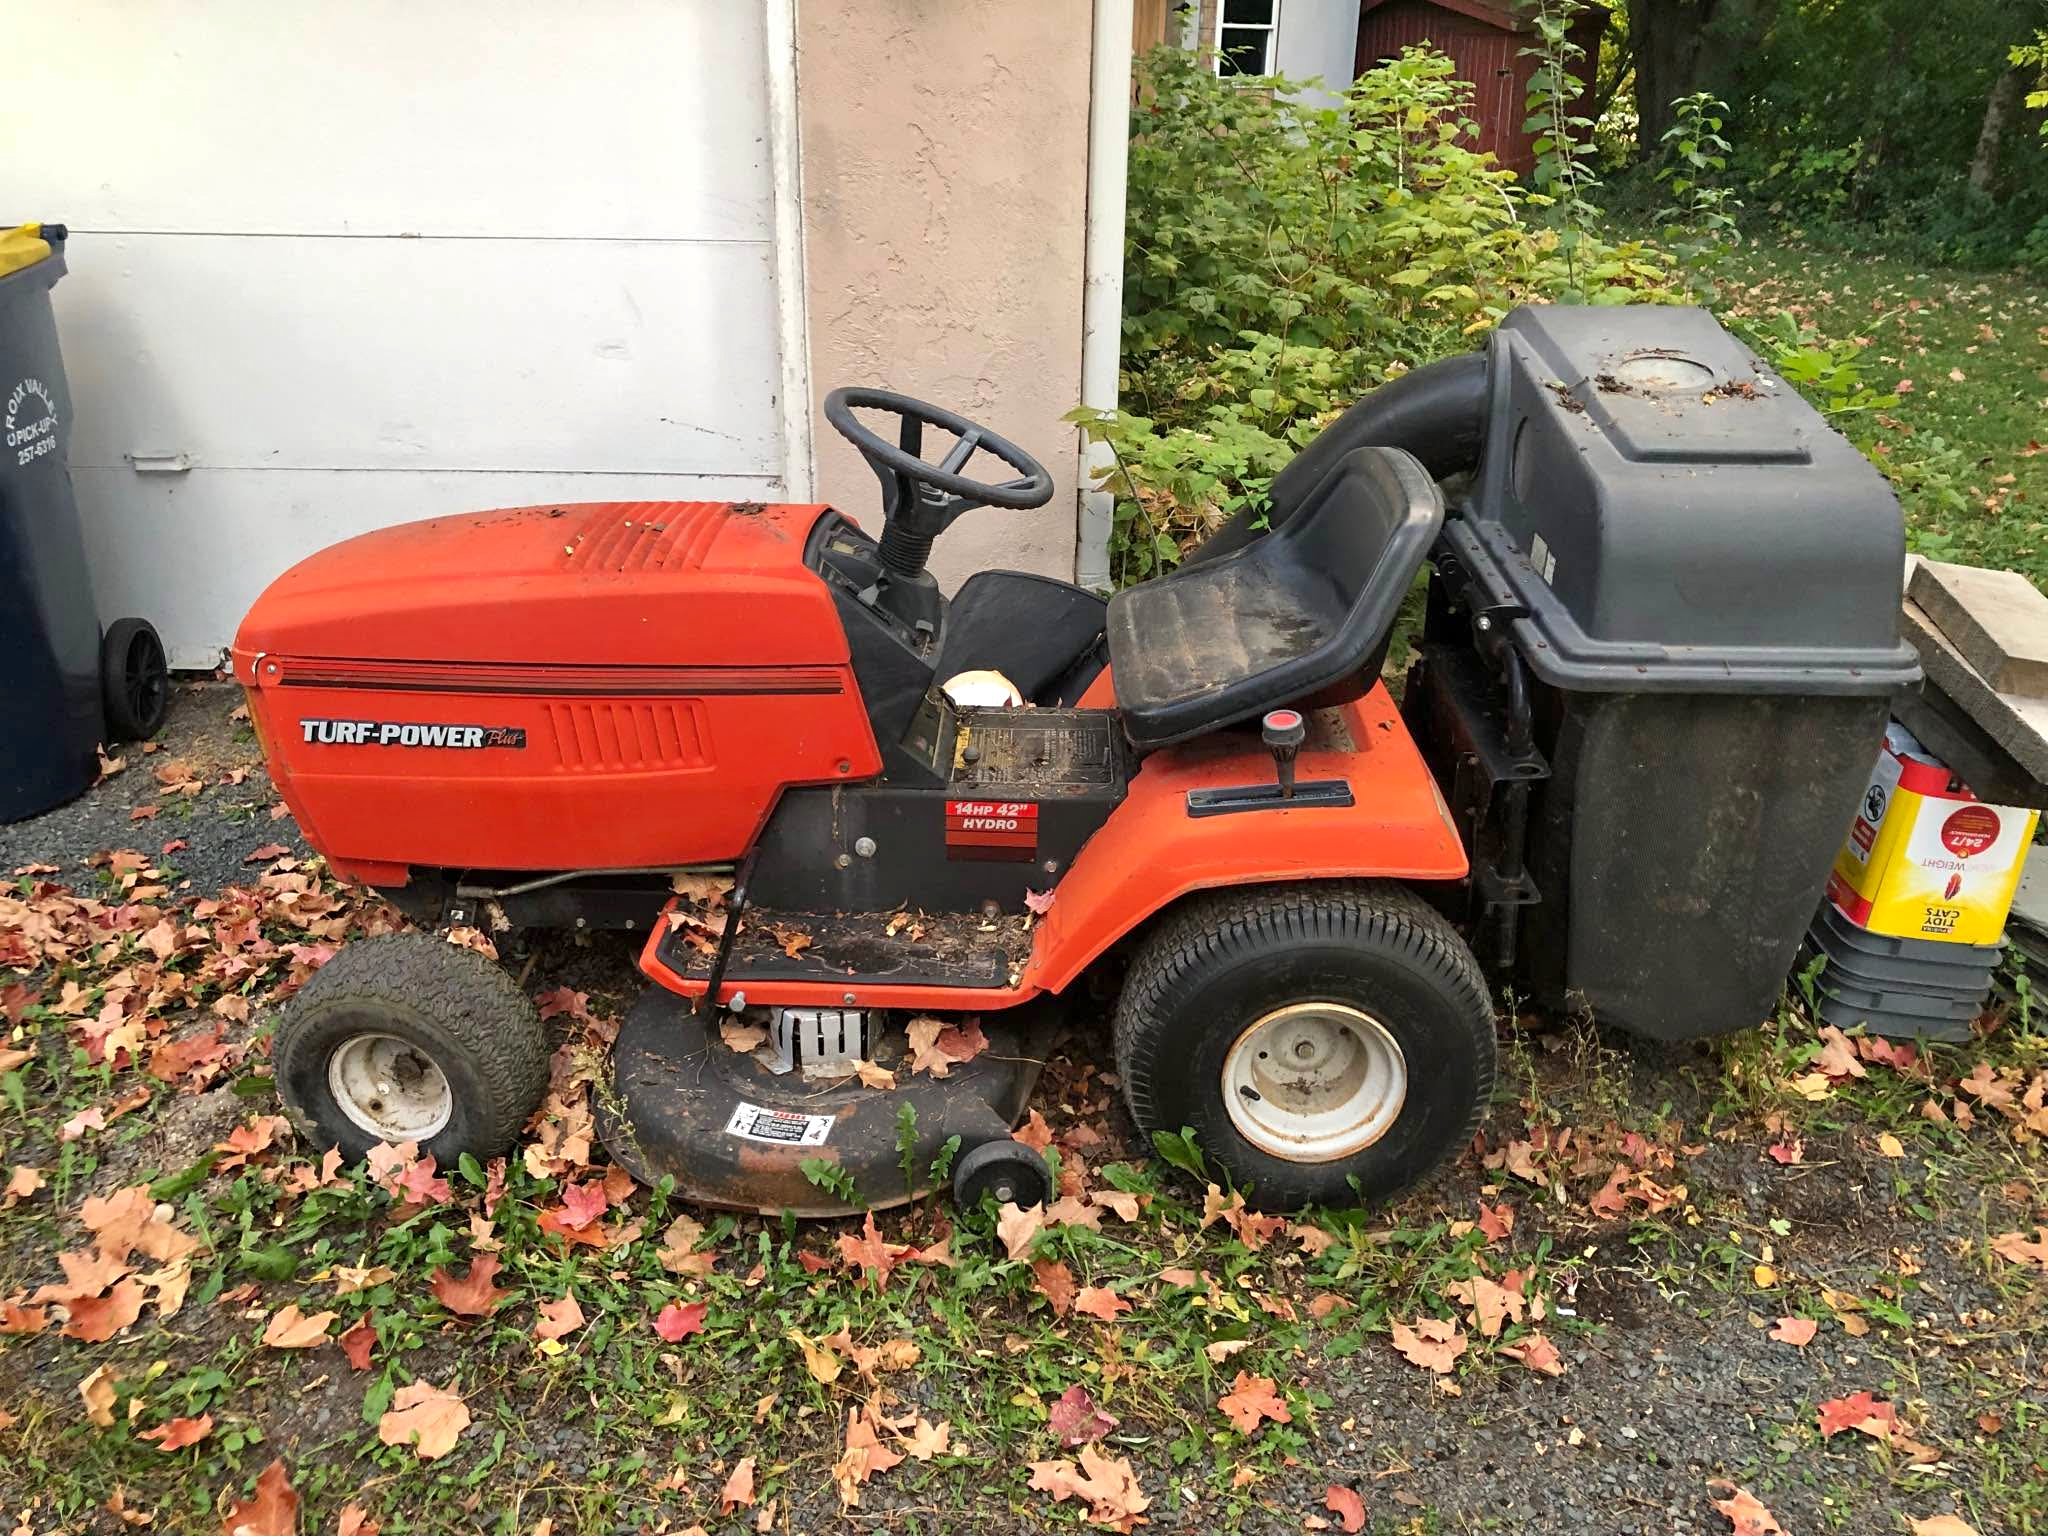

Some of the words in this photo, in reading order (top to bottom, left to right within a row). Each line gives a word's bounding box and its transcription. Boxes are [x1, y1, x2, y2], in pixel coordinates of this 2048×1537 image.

[16, 416, 51, 445] PICK-UP
[299, 720, 484, 748] TURF-POWER
[484, 729, 523, 746] Plus
[955, 802, 993, 815] 14HP
[996, 803, 1028, 817] 42"
[962, 818, 1018, 830] HYDRO
[1951, 836, 1984, 848] 24/7
[1926, 907, 1960, 919] CATS
[1924, 917, 1955, 928] TIDY
